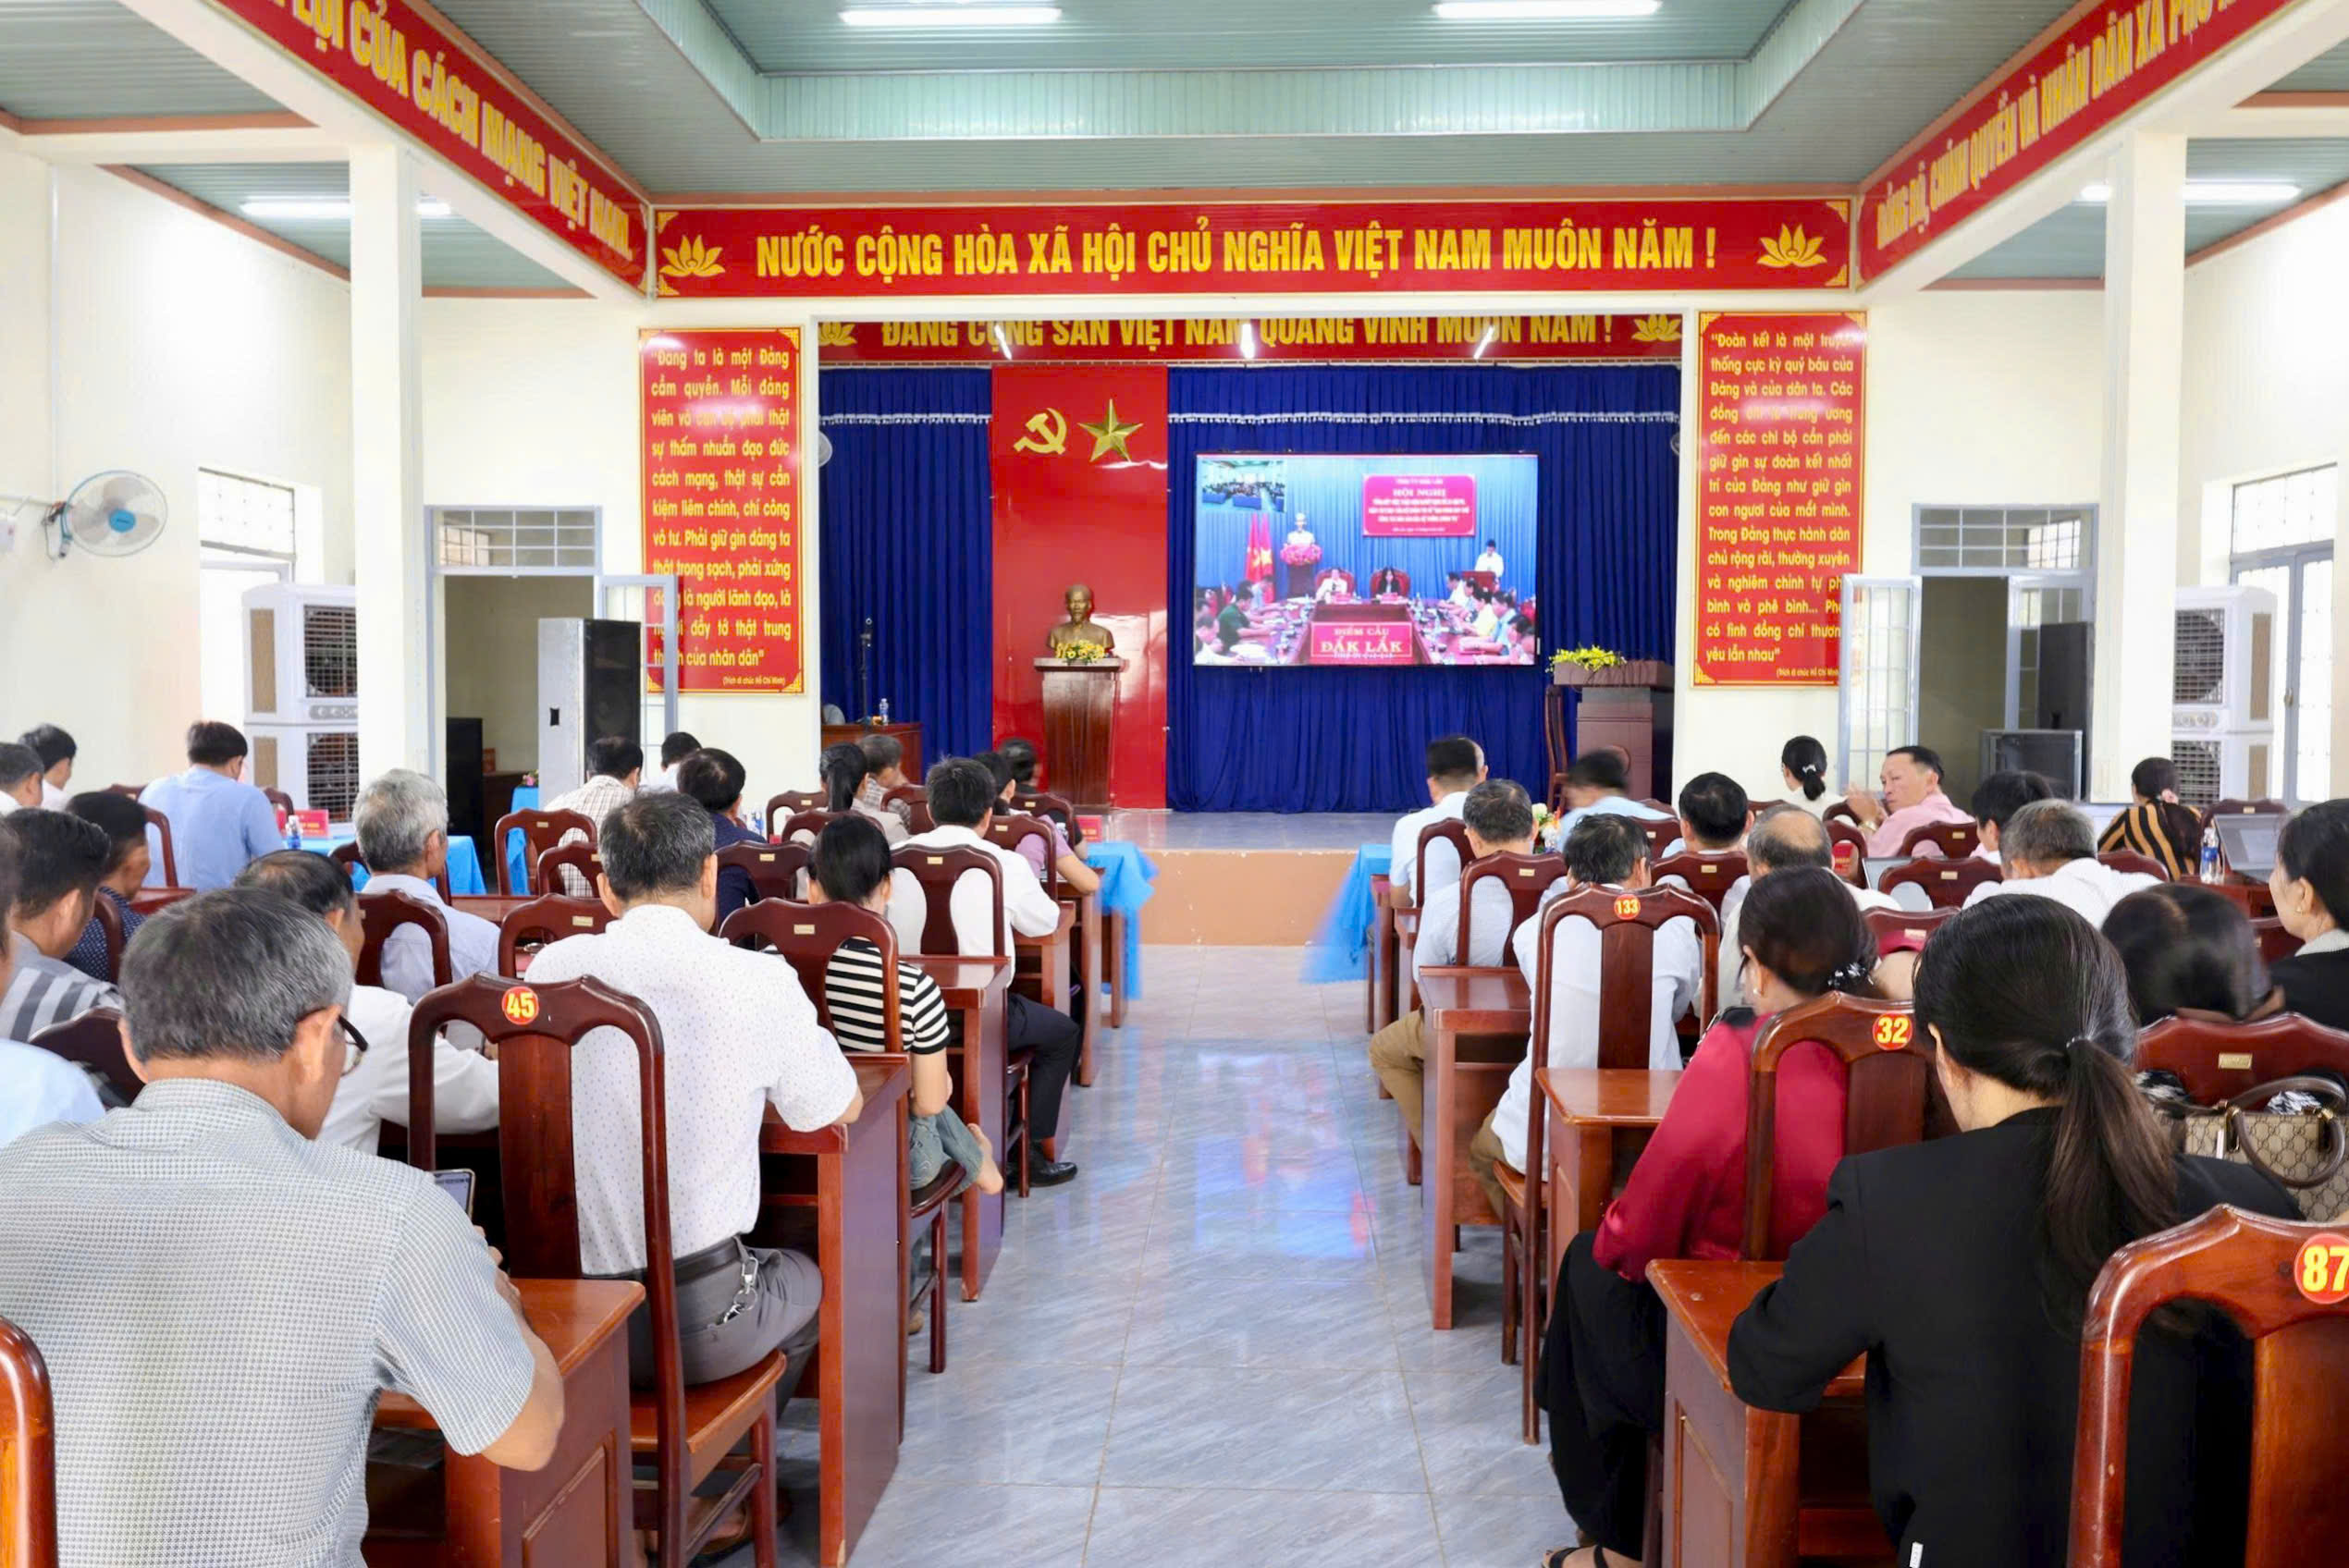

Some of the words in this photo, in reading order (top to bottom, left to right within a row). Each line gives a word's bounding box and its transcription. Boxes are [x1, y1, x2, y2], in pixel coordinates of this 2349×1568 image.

[2041, 43, 2090, 136] NHÂN
[2092, 10, 2134, 101] DÂN
[350, 0, 409, 99] CỦA
[413, 50, 479, 149] CÁCH
[482, 101, 546, 197] MẠNG
[548, 153, 589, 231] VIỆT
[757, 225, 843, 277] NƯỚC
[855, 225, 942, 284] CỘNG
[954, 223, 1018, 275] HÒA
[1027, 225, 1073, 274] XÃ
[1083, 223, 1136, 281] HỘI
[1148, 215, 1211, 273] CHỦ
[1224, 221, 1325, 272] NGHĨA
[1334, 220, 1403, 278] VIỆT
[1414, 228, 1492, 270] NAM
[1503, 218, 1602, 270] MUÔN
[1613, 217, 1693, 270] NĂM
[1363, 317, 1428, 345] VINH
[1777, 331, 1787, 348] là
[1793, 334, 1814, 350] một
[732, 348, 752, 370] một
[1710, 356, 1741, 375] thống
[1833, 356, 1853, 372] của
[1762, 380, 1782, 397] của
[1787, 382, 1807, 397] dân
[1831, 381, 1853, 397] Các
[652, 409, 673, 426] viên
[769, 408, 790, 431] thật
[1736, 430, 1756, 444] các
[652, 468, 679, 486] cách
[724, 470, 745, 491] thật
[1726, 476, 1746, 492] của
[682, 498, 704, 516] liêm
[744, 497, 759, 516] chí
[763, 499, 790, 521] công
[1709, 505, 1729, 517] con
[1770, 501, 1789, 517] của
[653, 531, 666, 546] vô
[684, 526, 707, 546] Phải
[780, 531, 791, 546] ta
[1709, 527, 1737, 545] Trong
[677, 559, 704, 581] trong
[738, 557, 761, 581] phải
[765, 558, 791, 581] xứng
[684, 589, 694, 606] là
[781, 589, 791, 606] là
[736, 619, 757, 641] thật
[764, 622, 791, 641] trung
[686, 647, 707, 666] của
[709, 649, 734, 666] nhân
[1617, 900, 1640, 915] 133
[505, 992, 537, 1020] 45
[1876, 1019, 1909, 1042] 32
[2302, 1245, 2349, 1292] 87
